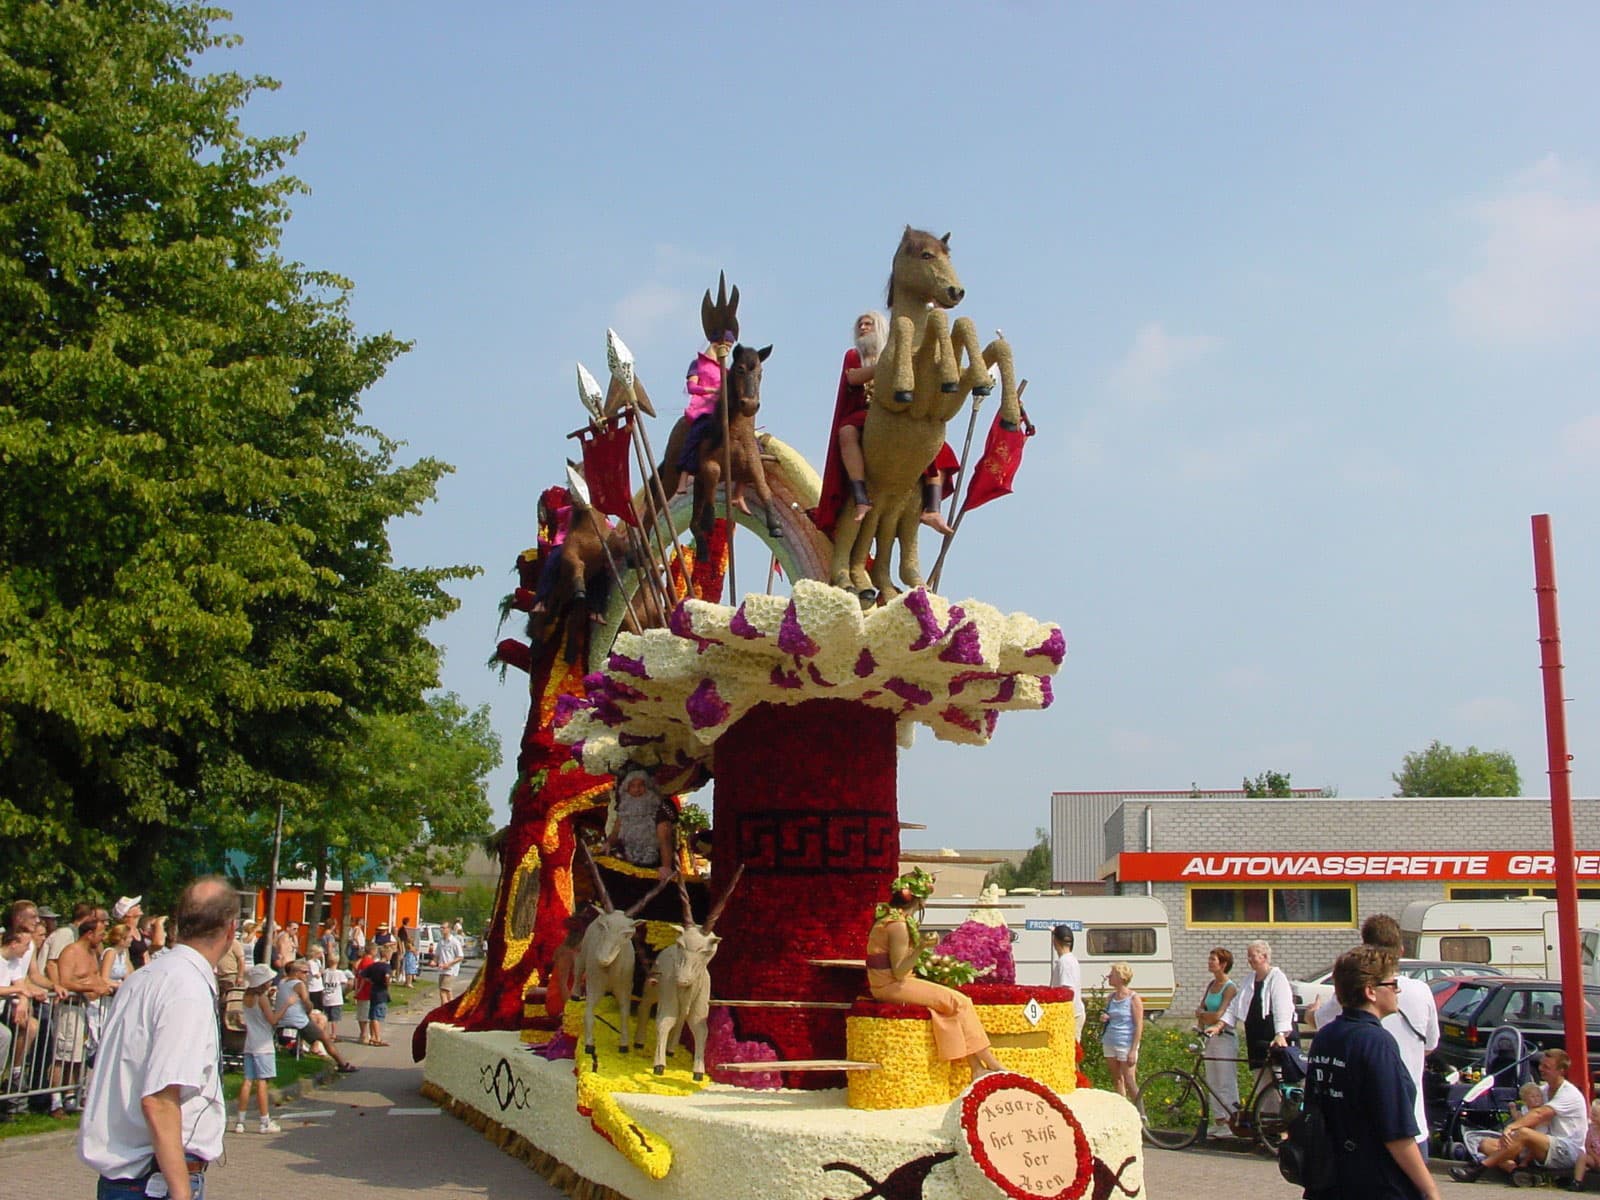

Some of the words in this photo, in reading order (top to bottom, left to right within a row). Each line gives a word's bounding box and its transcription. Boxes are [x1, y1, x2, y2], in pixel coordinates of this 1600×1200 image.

[1181, 856, 1489, 876] AUTOWASSERETTE
[1508, 855, 1600, 875] GRE
[1030, 1003, 1037, 1019] 9
[989, 1131, 1014, 1150] het
[1021, 1124, 1057, 1144] Rijk
[1022, 1151, 1049, 1168] der
[1019, 1173, 1065, 1191] Asen
